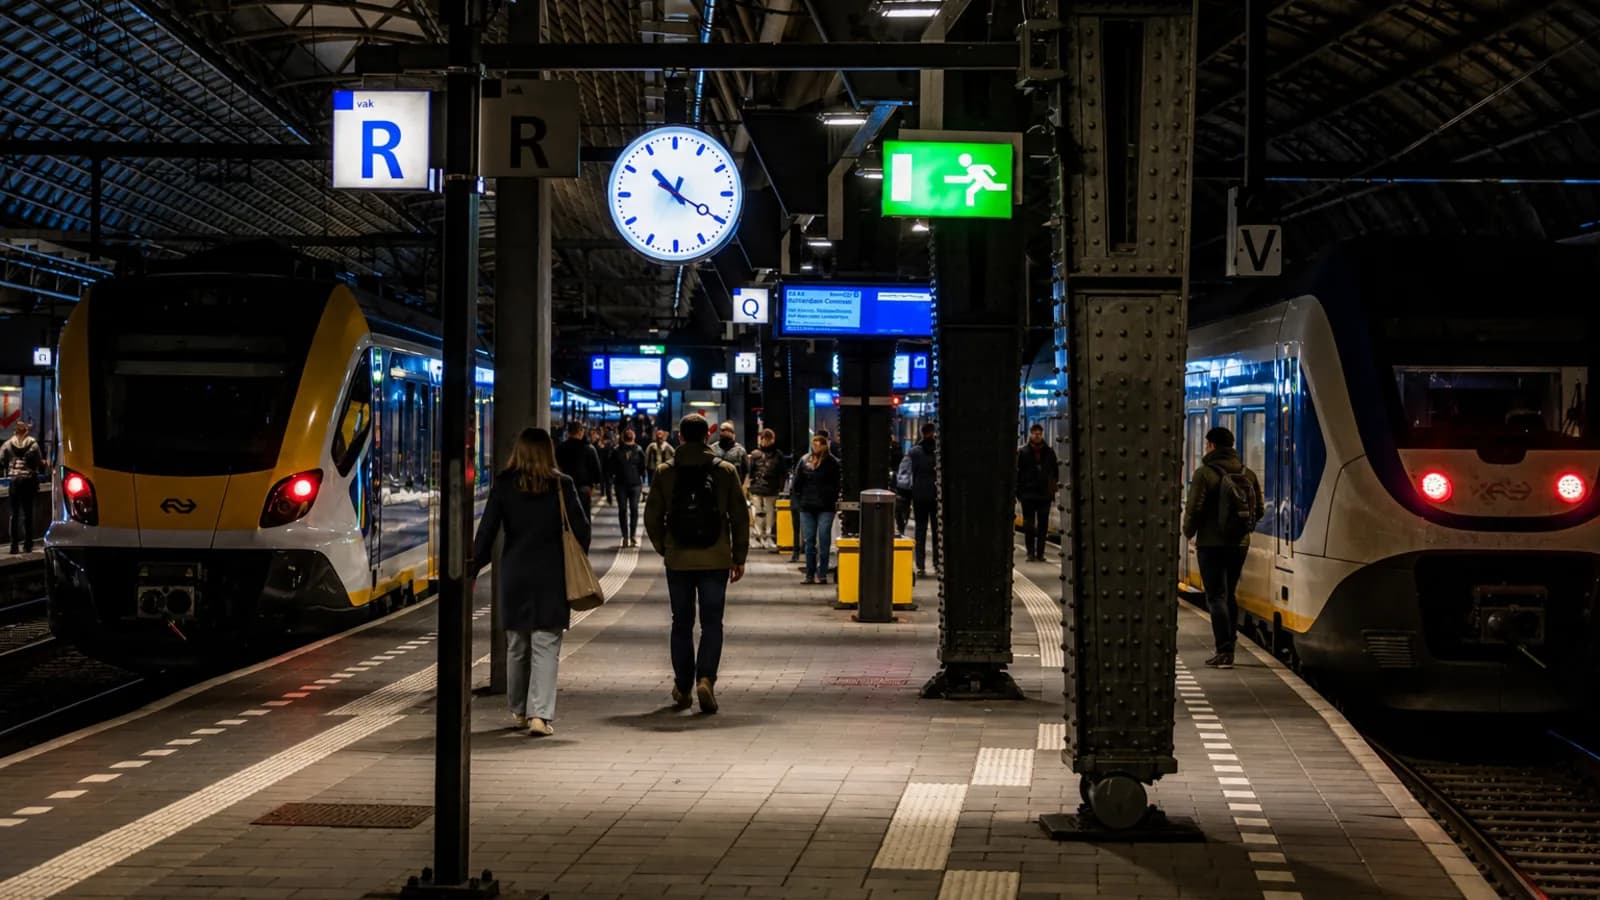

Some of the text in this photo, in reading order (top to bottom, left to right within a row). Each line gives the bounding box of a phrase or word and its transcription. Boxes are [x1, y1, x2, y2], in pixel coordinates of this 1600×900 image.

[356, 99, 375, 108] vak
[361, 120, 404, 179] R
[510, 116, 551, 169] R
[1241, 229, 1277, 272] V
[742, 298, 759, 320] Q
